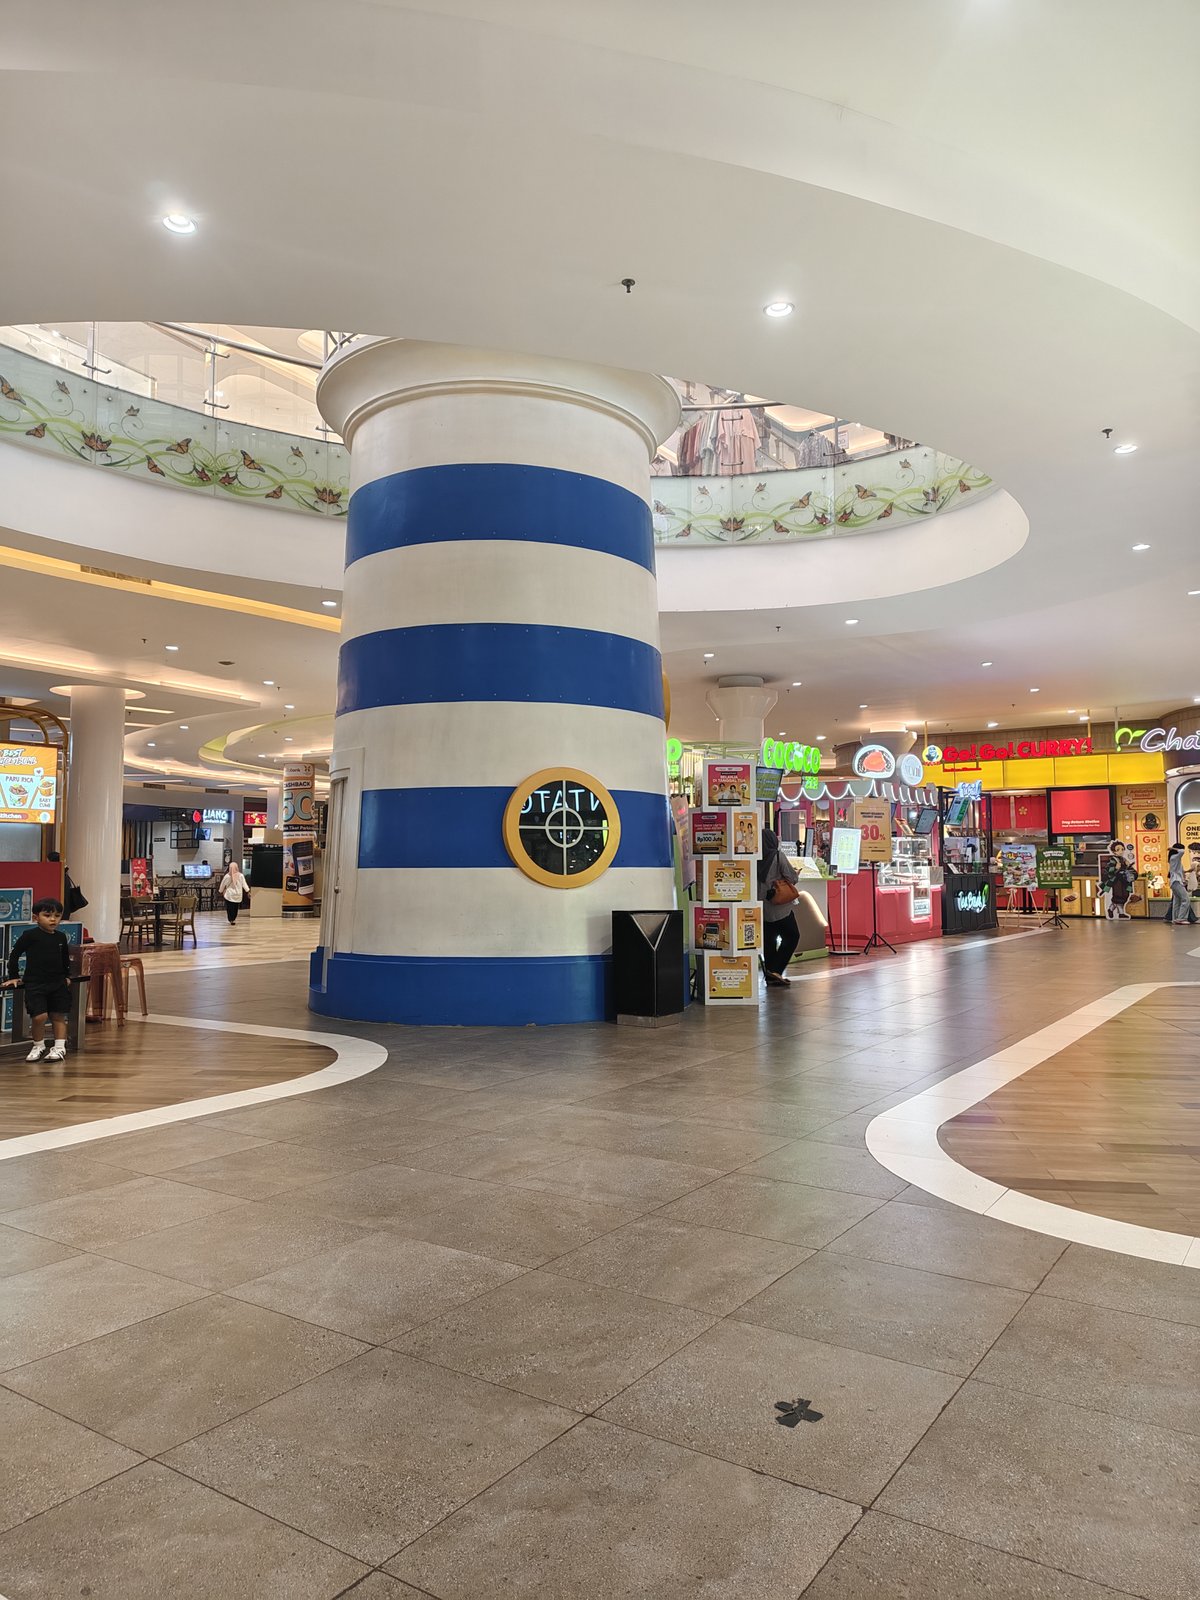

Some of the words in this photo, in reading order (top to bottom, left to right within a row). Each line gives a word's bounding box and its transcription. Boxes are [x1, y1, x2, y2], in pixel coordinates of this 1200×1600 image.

[1140, 727, 1200, 752] Cha
[943, 744, 976, 761] Go!
[979, 742, 1014, 759] Go!
[1017, 737, 1093, 758] CURRY!
[203, 809, 228, 820] LIANG
[860, 824, 887, 841] 30%
[1142, 836, 1160, 844] Go!
[1143, 845, 1161, 853] Go!
[1143, 854, 1161, 862] Go!
[1143, 864, 1162, 872] Go!
